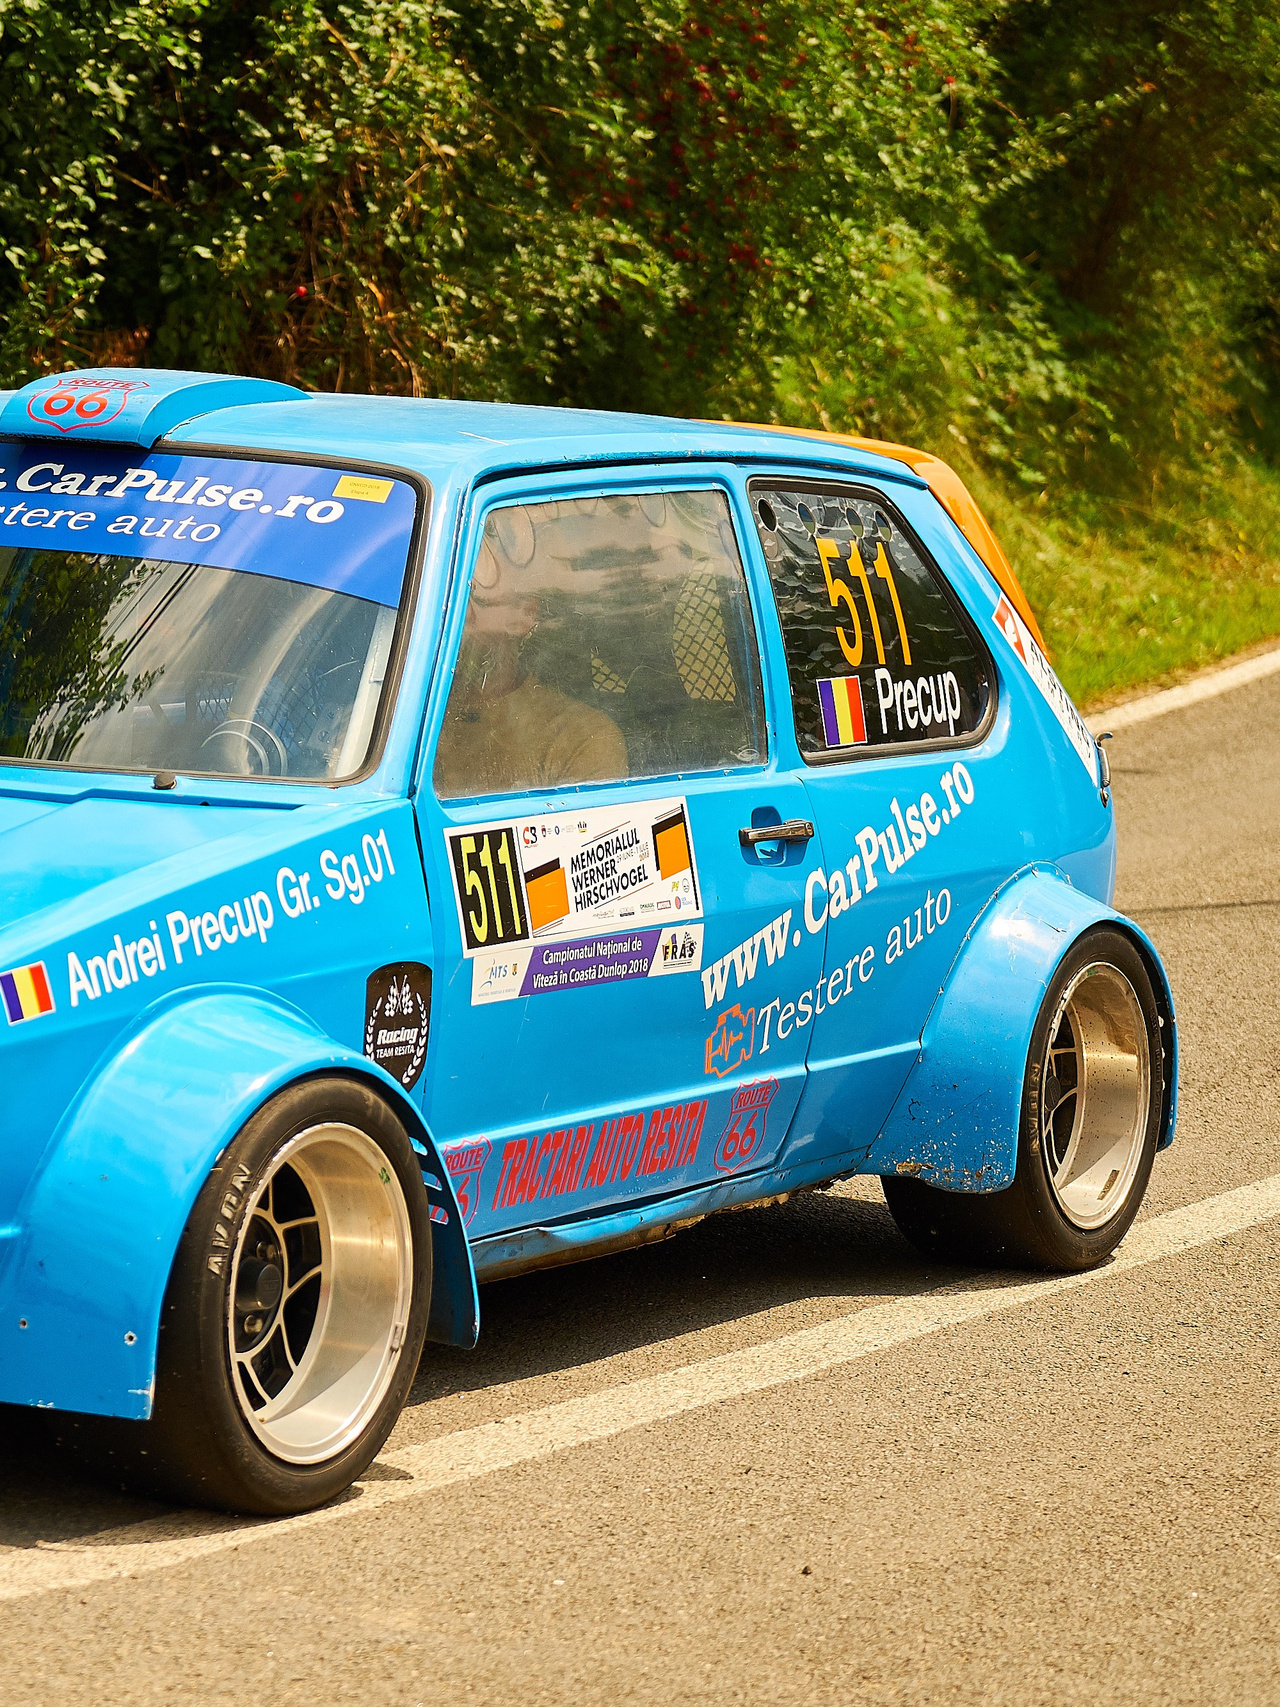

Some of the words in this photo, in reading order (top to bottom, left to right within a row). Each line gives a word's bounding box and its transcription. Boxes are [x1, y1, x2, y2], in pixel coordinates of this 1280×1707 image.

[43, 386, 111, 419] 66
[68, 379, 137, 389] ROUTE
[122, 511, 222, 543] auto
[815, 538, 913, 667] 511
[874, 667, 962, 737] Precup
[570, 828, 640, 875] MEMORIALUL
[460, 831, 522, 943] 511
[571, 858, 618, 893] WERNER
[574, 864, 649, 913] HIRSCHVOGEL
[700, 761, 975, 1010] www.CarPulse.ro
[67, 919, 167, 1007] Andrei
[166, 889, 275, 964] Precup
[276, 865, 321, 920] Gr.
[324, 828, 397, 905] Sg.01
[532, 970, 558, 989] Viteză
[558, 969, 569, 985] în
[569, 964, 597, 984] Coastă
[597, 960, 628, 979] Dunlop
[628, 957, 649, 974] 2018
[542, 941, 596, 965] Campionatul
[631, 935, 642, 952] de
[756, 944, 875, 1055] Testere
[884, 887, 952, 966] auto
[376, 1026, 419, 1046] Racing
[376, 1047, 394, 1059] TEAM
[394, 1044, 416, 1056] RESITA
[735, 1084, 773, 1109] ROUTE
[445, 1146, 485, 1171] ROUTE
[491, 1123, 595, 1211] TRACTARI
[582, 1112, 645, 1190] AUTO
[635, 1099, 709, 1177] RESITA
[722, 1109, 758, 1162] 66
[206, 1162, 254, 1281] AVON
